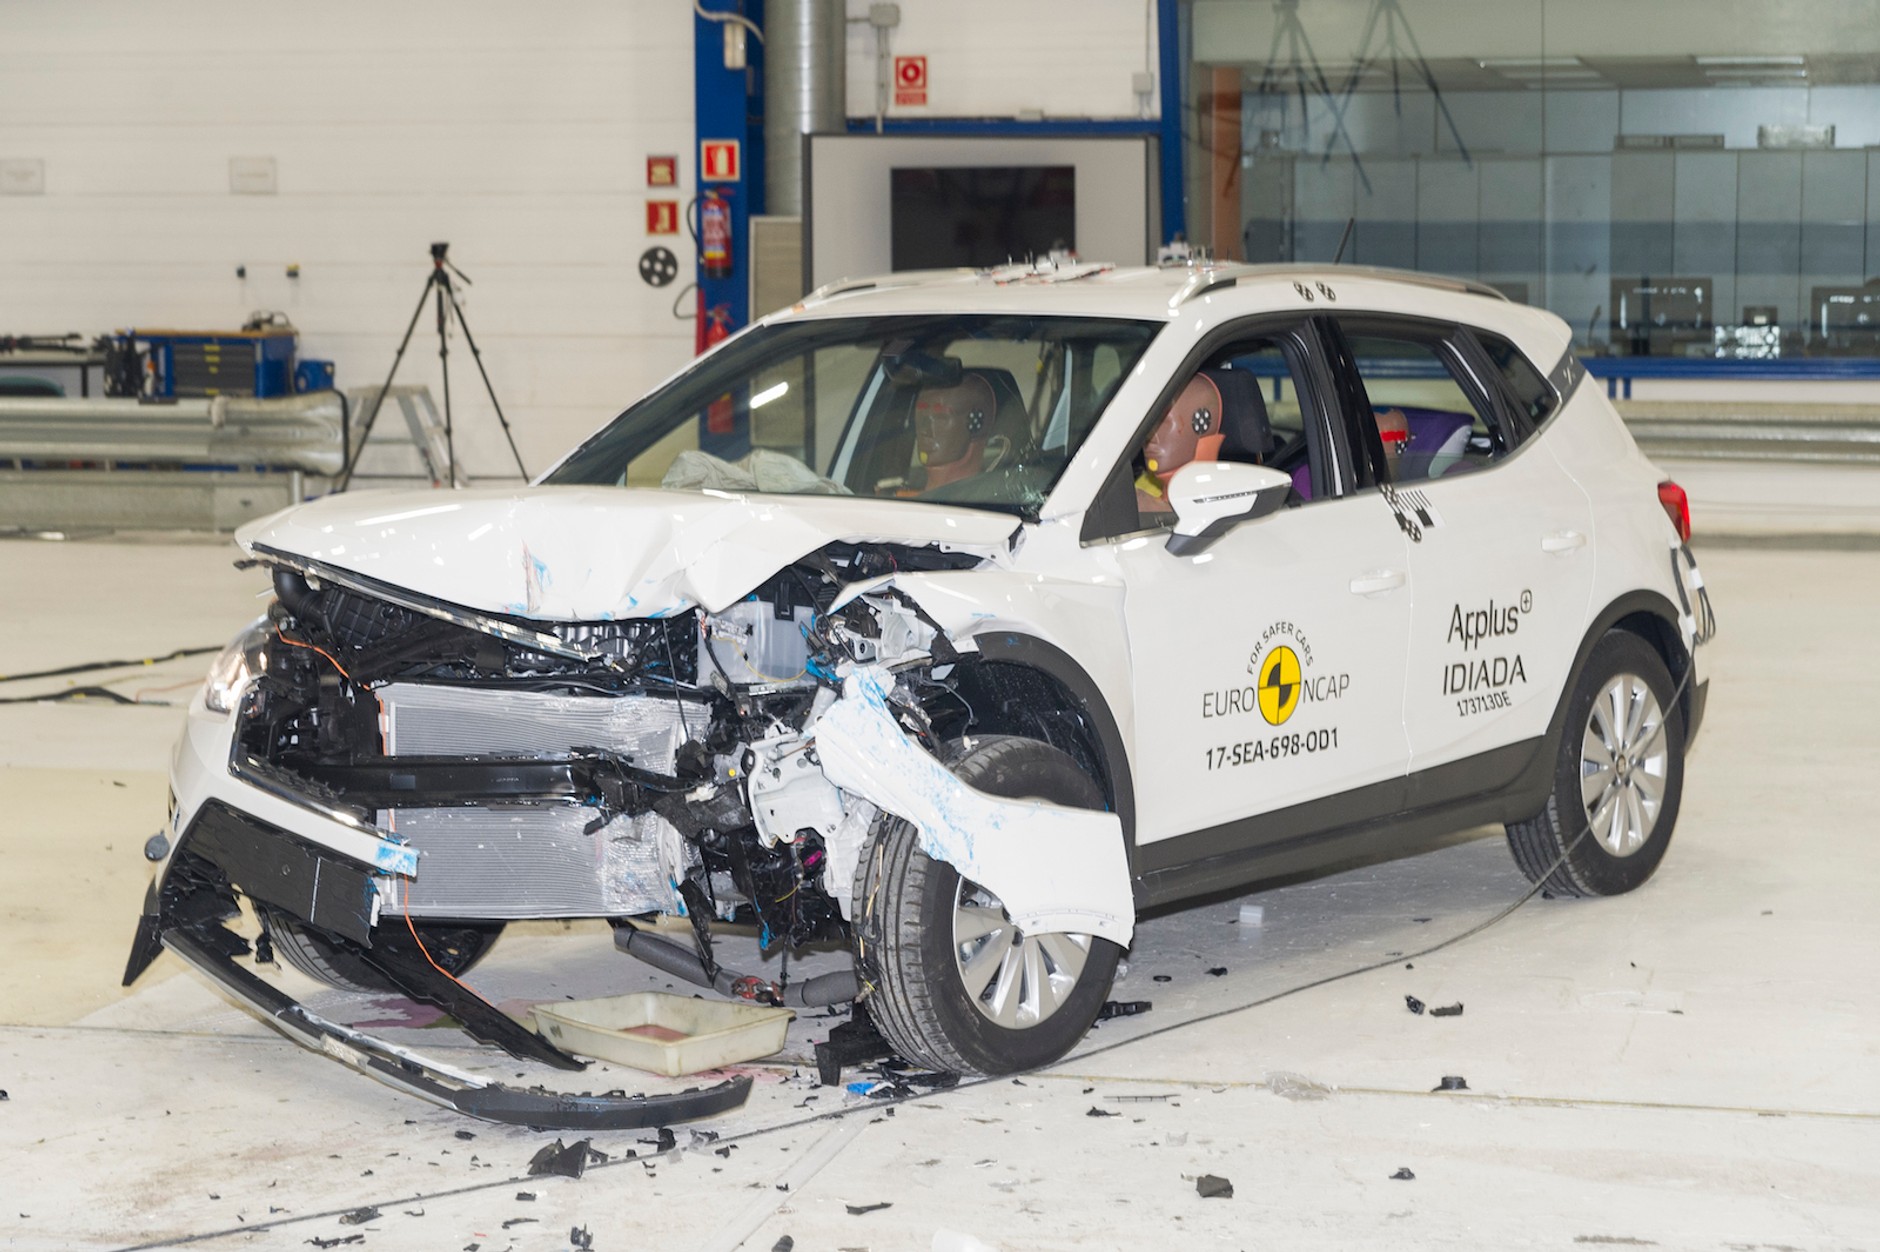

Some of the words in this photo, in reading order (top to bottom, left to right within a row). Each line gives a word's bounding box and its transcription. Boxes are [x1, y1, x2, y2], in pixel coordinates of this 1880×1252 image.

[1447, 598, 1519, 651] Applus
[1247, 641, 1263, 675] FOR
[1262, 621, 1294, 643] SAFER
[1295, 629, 1314, 667] CARS
[1202, 686, 1255, 718] EURO
[1303, 673, 1350, 704] NCAP
[1443, 654, 1527, 696] IDIADA
[1457, 690, 1512, 717] 173713DE
